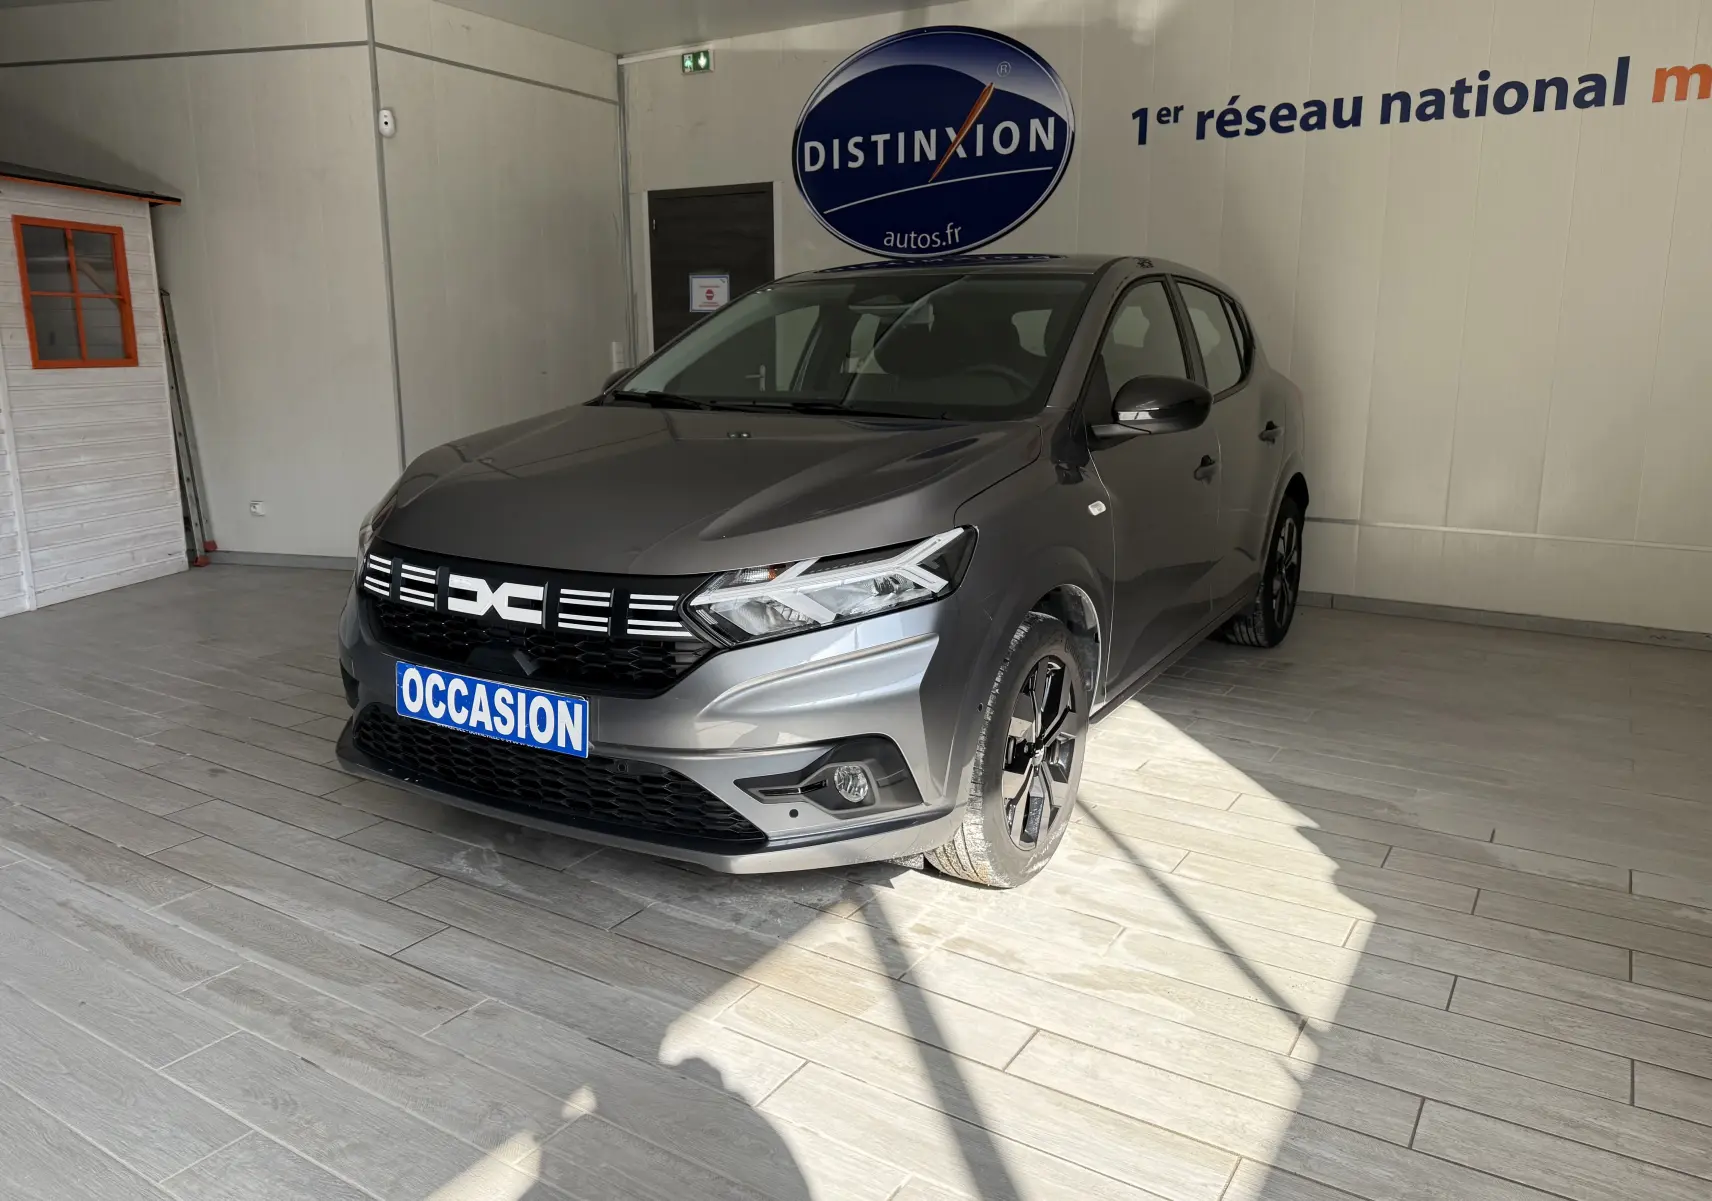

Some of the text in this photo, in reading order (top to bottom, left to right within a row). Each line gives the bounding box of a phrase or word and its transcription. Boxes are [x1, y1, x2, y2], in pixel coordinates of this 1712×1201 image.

[1132, 105, 1184, 145] 1er
[1196, 95, 1363, 140] réseau
[1380, 56, 1630, 125] national
[804, 117, 1055, 172] DISTINXION
[883, 222, 962, 249] autos.fr
[402, 667, 583, 751] OCCASION
